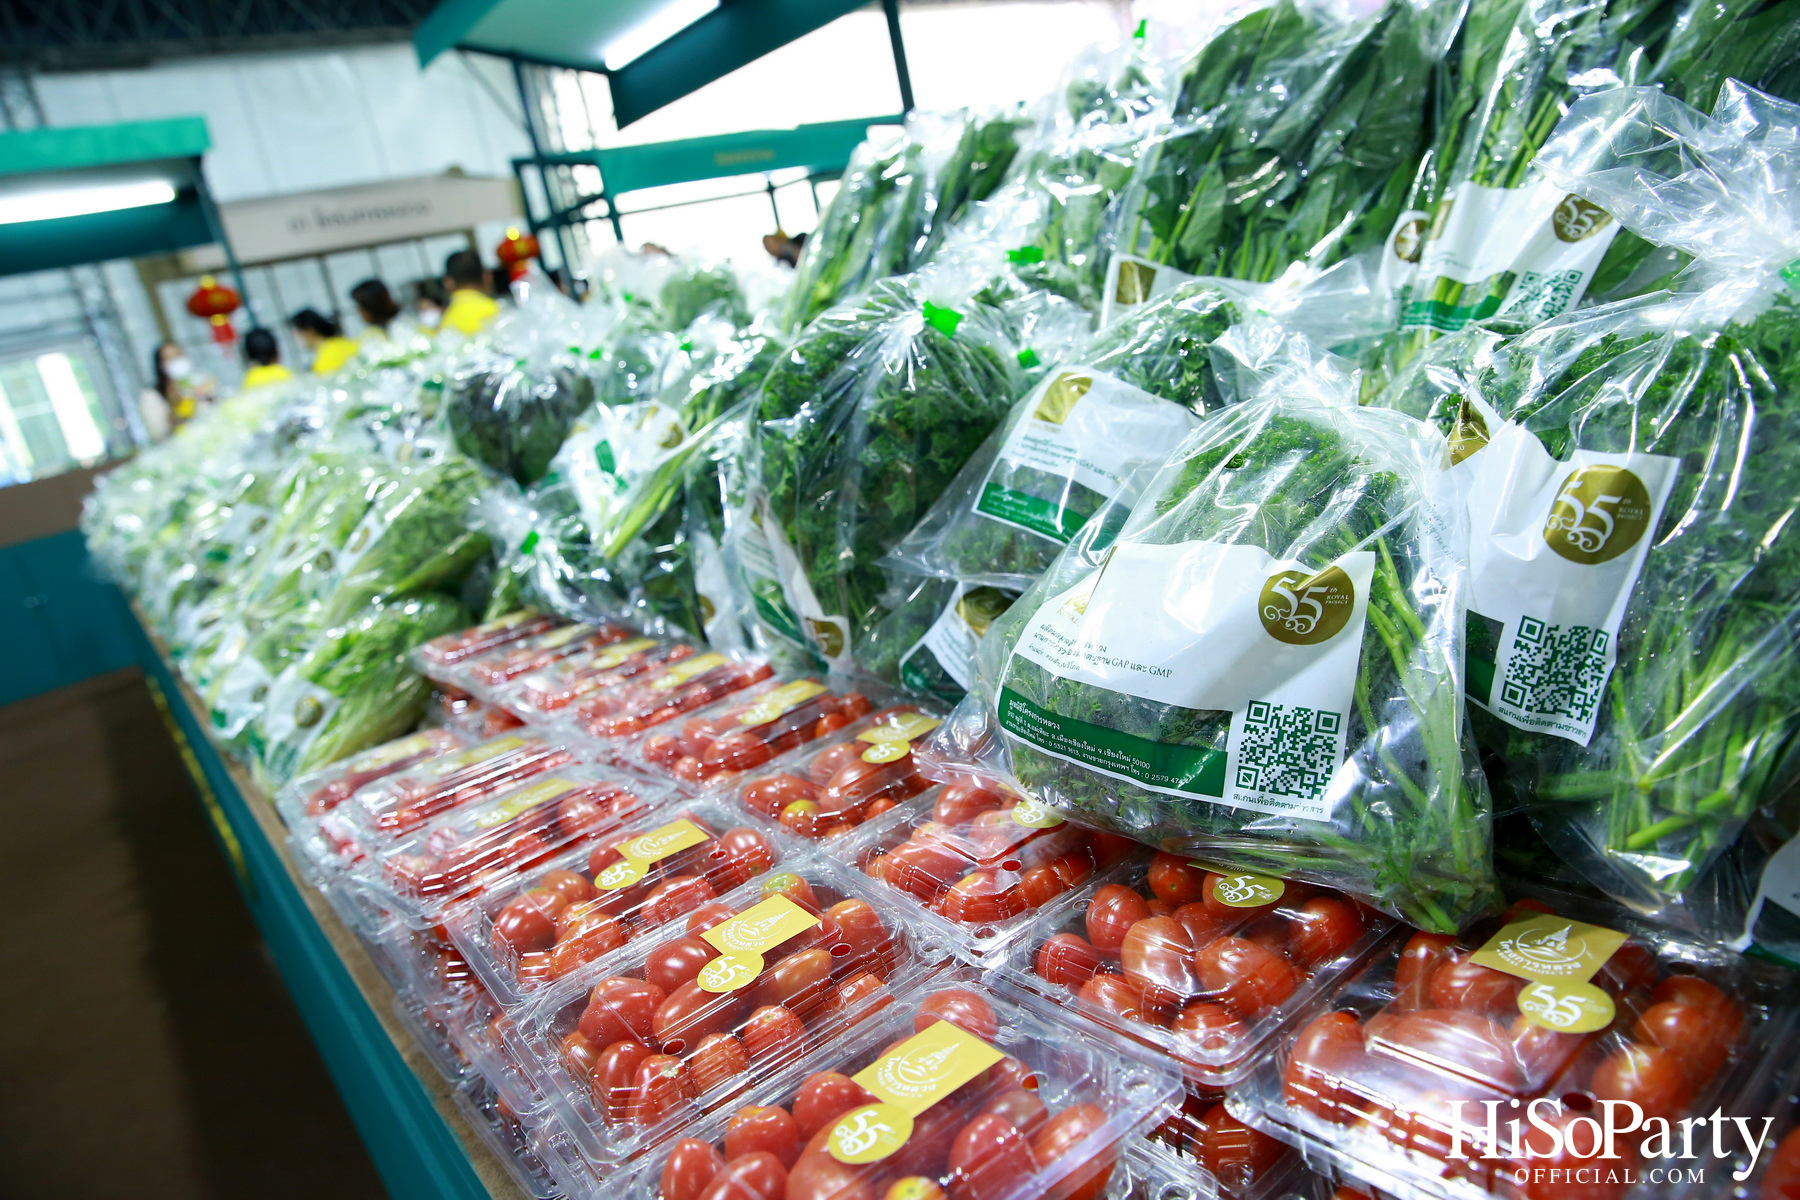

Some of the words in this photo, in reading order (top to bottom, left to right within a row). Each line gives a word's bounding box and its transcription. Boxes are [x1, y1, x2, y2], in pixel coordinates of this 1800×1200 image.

[1547, 481, 1623, 553] 55
[1264, 576, 1328, 634] 55
[1111, 657, 1130, 669] GAP
[1130, 663, 1147, 674] และ
[1148, 665, 1173, 679] GMP
[1132, 757, 1151, 770] 50100
[1151, 774, 1169, 783] 2579
[1219, 875, 1267, 903] 55
[702, 956, 747, 988] 55
[1522, 985, 1588, 1027] 55
[835, 1110, 892, 1156] 55
